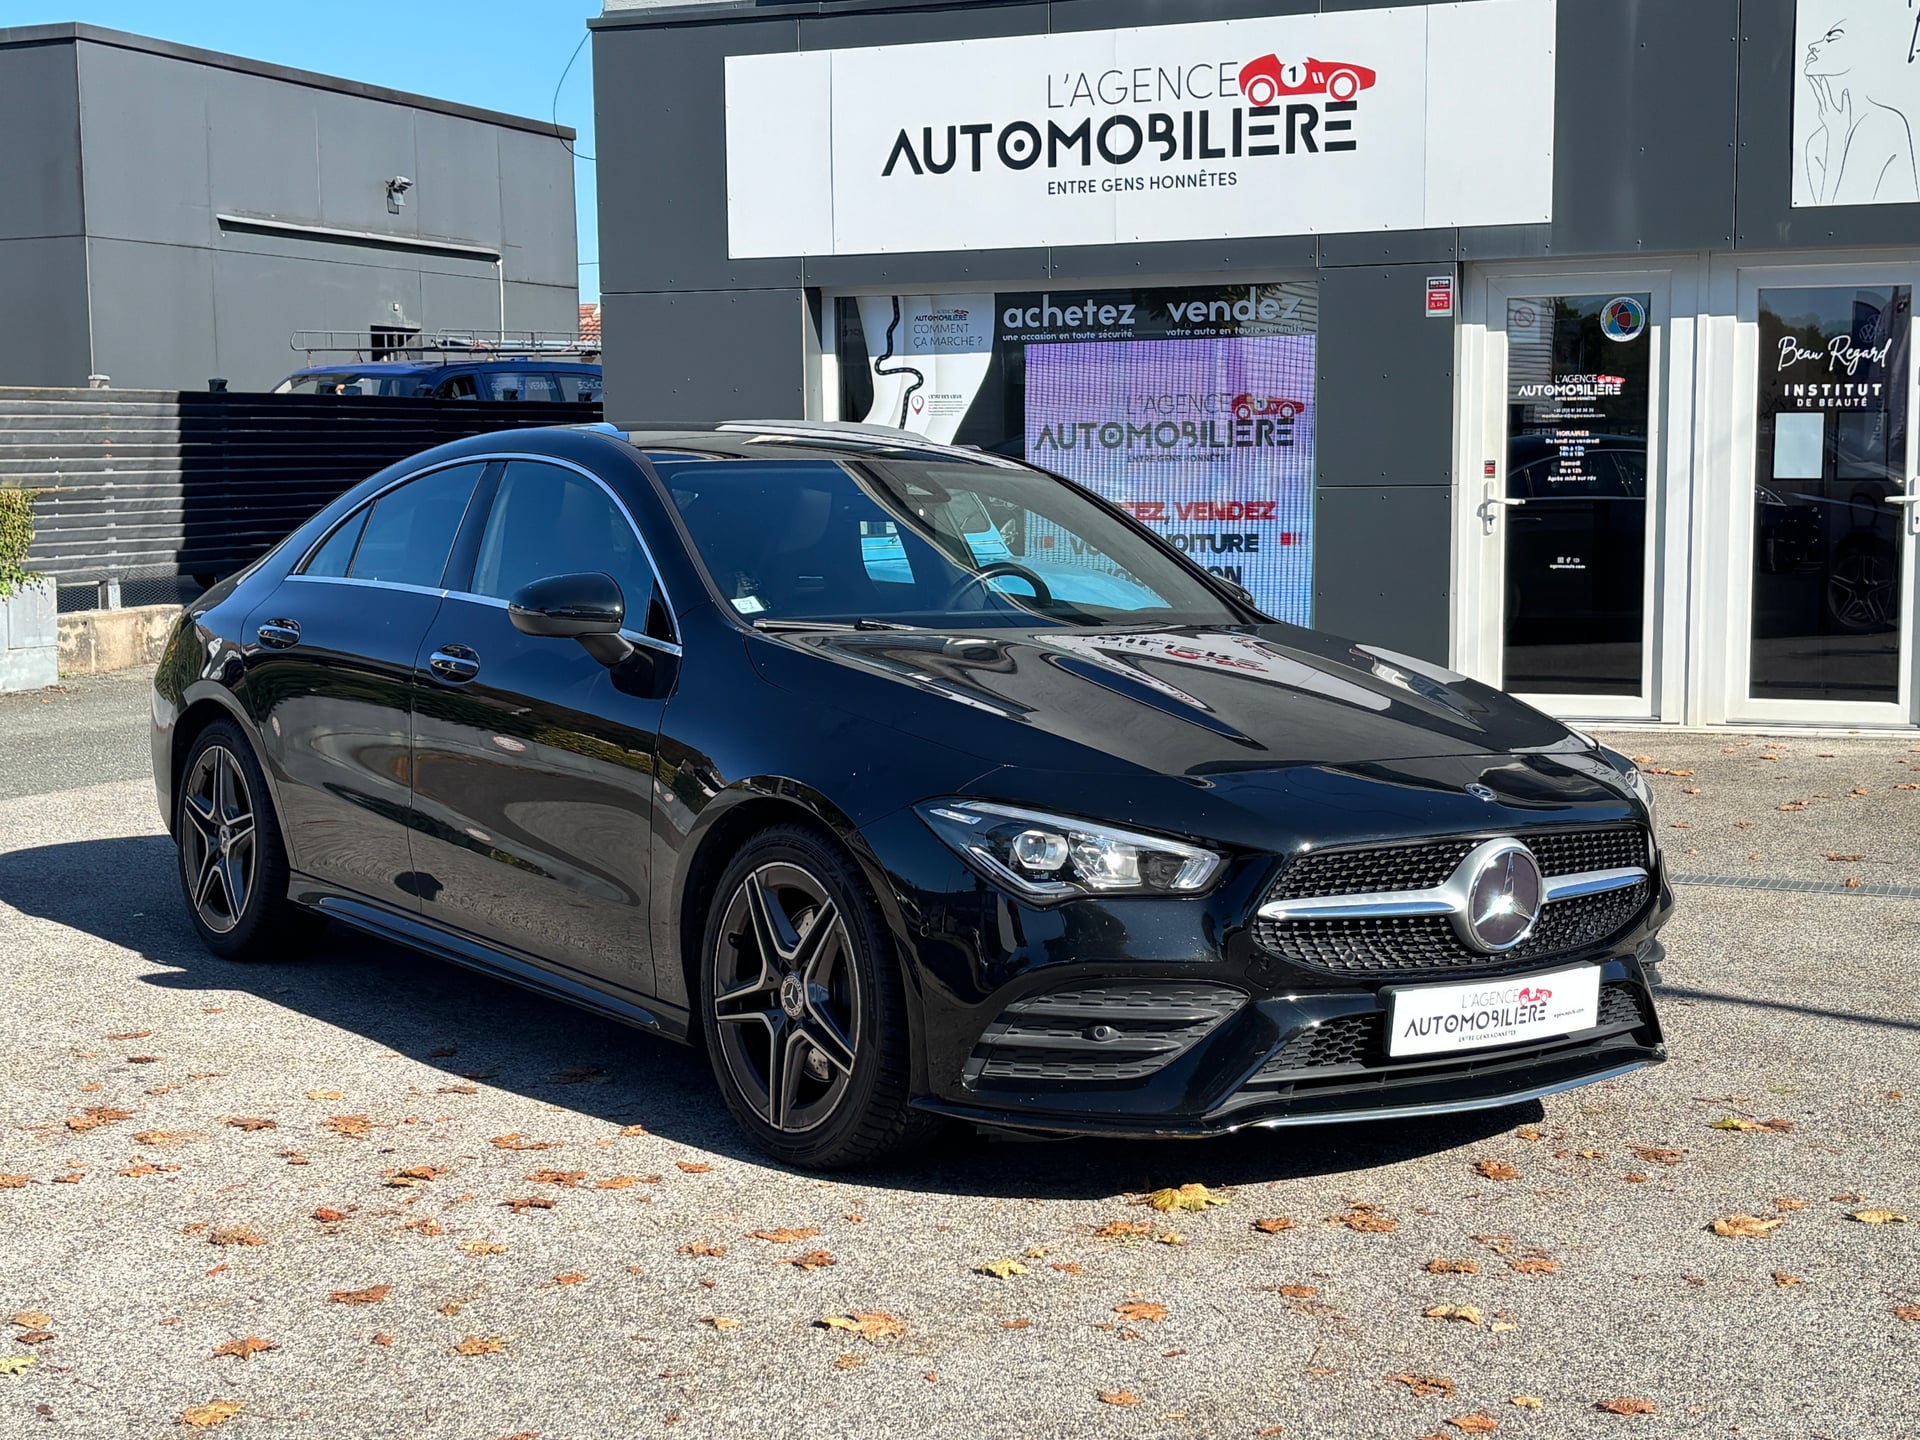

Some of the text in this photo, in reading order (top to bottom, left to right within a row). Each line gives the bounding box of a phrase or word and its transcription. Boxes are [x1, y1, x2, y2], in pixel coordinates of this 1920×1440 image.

[1047, 61, 1240, 109] L'AGENCE
[1047, 170, 1238, 195] ENTRE GENS HONNÊTES
[1003, 286, 1303, 328] achetez vendez
[913, 323, 969, 334] COMMENT
[1020, 331, 1057, 341] occasion
[1059, 332, 1070, 340] en
[1072, 331, 1096, 340] toute
[1165, 327, 1192, 336] votre
[1193, 326, 1217, 336] auto
[1219, 327, 1232, 335] en
[1234, 325, 1261, 334] toute
[913, 336, 928, 348] ÇA
[930, 335, 976, 346] MARCHE
[1777, 334, 1893, 376] Beau Regard
[1554, 374, 1598, 384] L'AGENCE
[1783, 383, 1883, 397] INSTITUT
[1126, 393, 1232, 415] L'AGENCE
[1796, 397, 1868, 407] DE BEAUTÉ
[1174, 501, 1278, 521] VENDEZ
[1167, 533, 1259, 554] OITURE
[1461, 988, 1519, 1009] L'AGENCE
